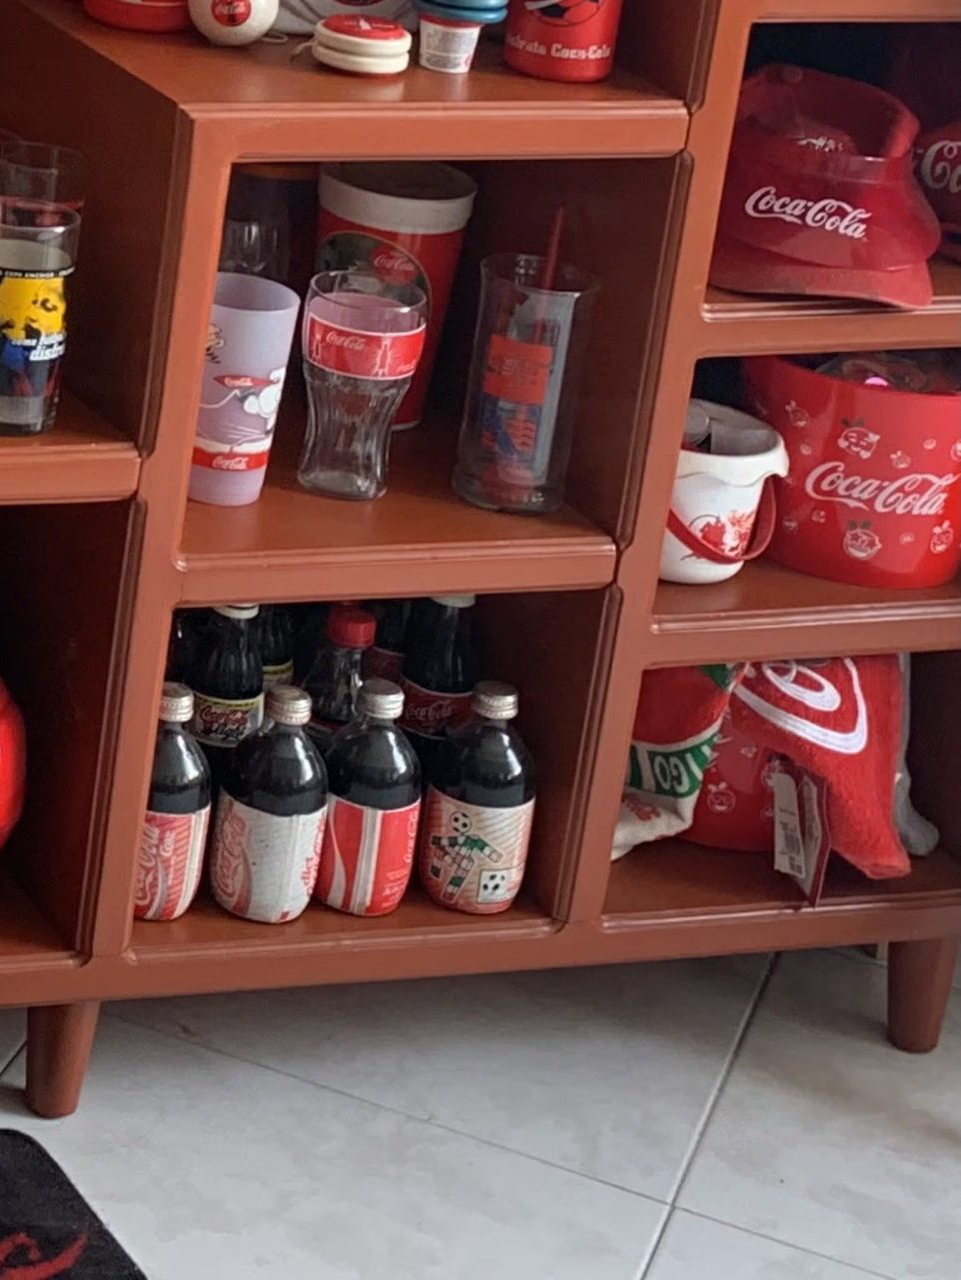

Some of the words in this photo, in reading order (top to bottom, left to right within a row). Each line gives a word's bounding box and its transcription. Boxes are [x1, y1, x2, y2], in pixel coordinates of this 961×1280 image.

[745, 184, 871, 241] Coca-Cola
[326, 330, 367, 351] Coca-Cola
[805, 460, 958, 517] Coca-Cola
